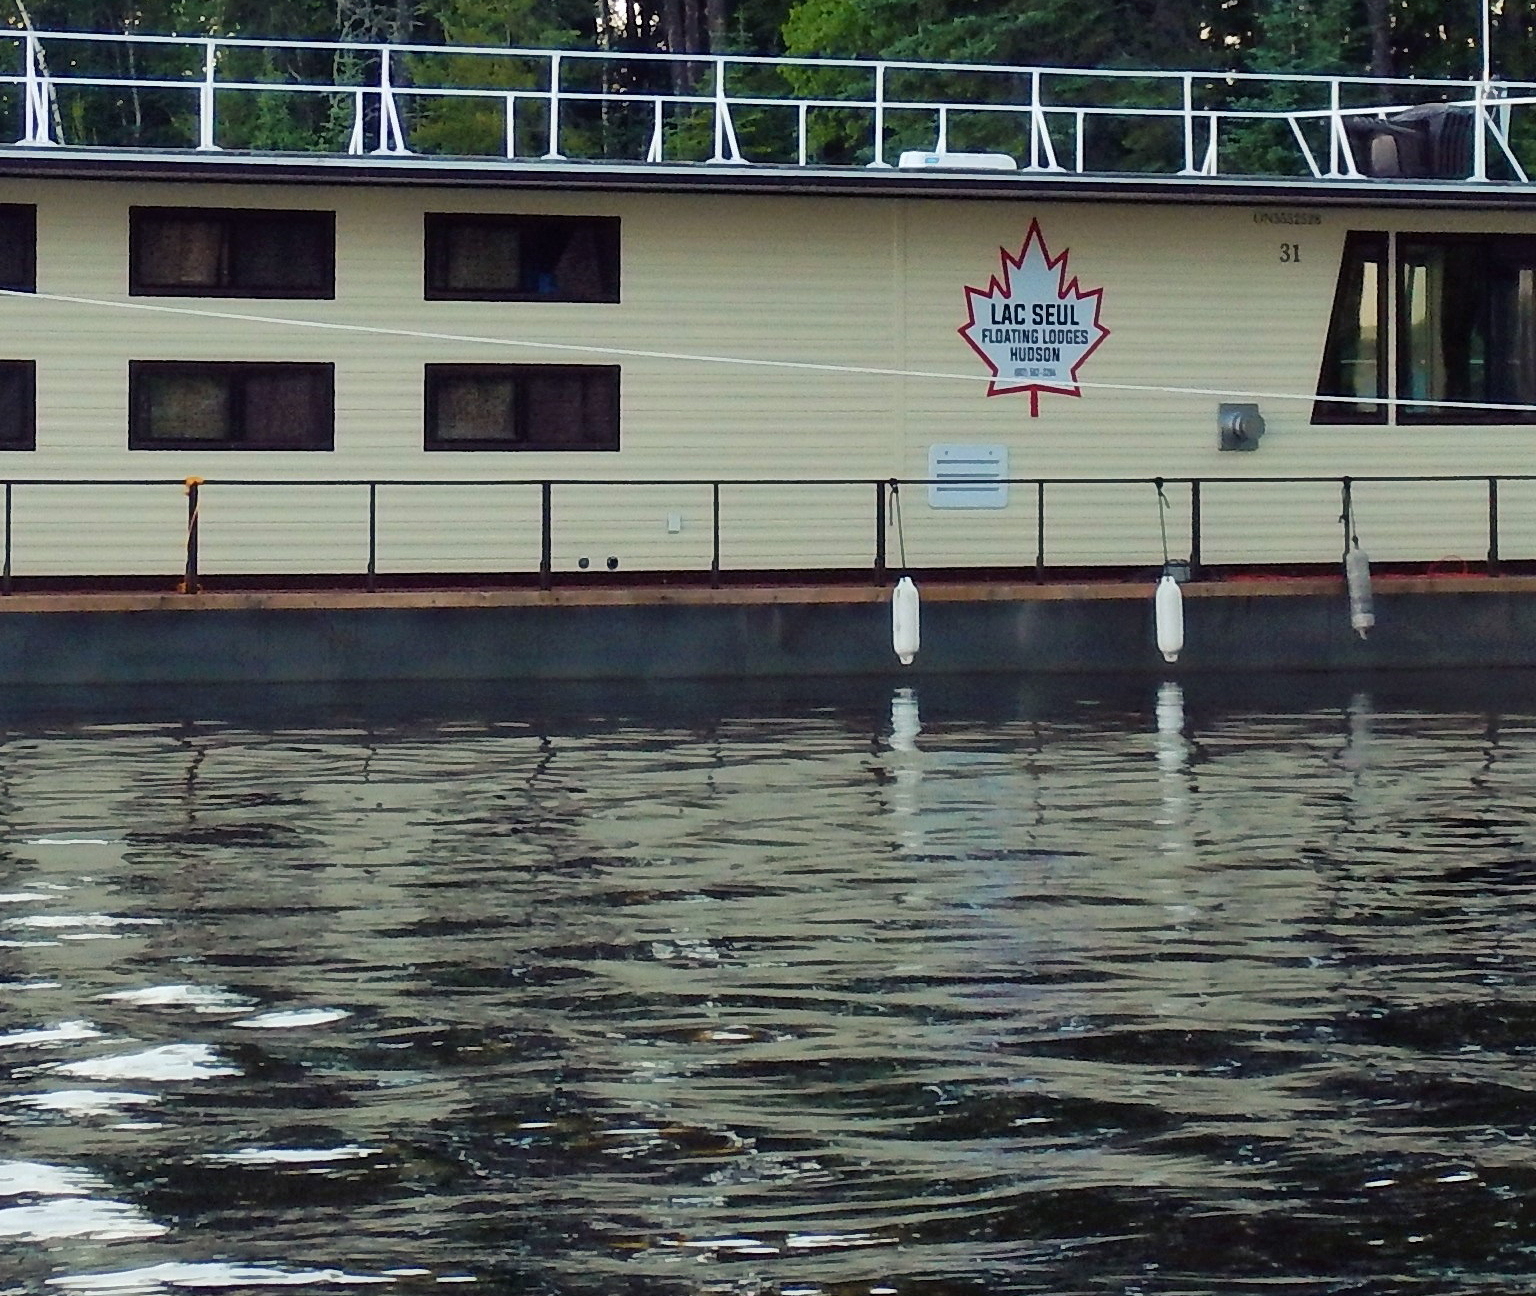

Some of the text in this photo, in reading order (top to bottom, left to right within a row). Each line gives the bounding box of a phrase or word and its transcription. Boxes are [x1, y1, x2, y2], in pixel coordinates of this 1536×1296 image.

[1279, 242, 1301, 263] 31
[991, 303, 1080, 326] LAC SEUL
[981, 328, 1089, 345] FLOATING LODGES
[1010, 347, 1061, 362] HUDSON
